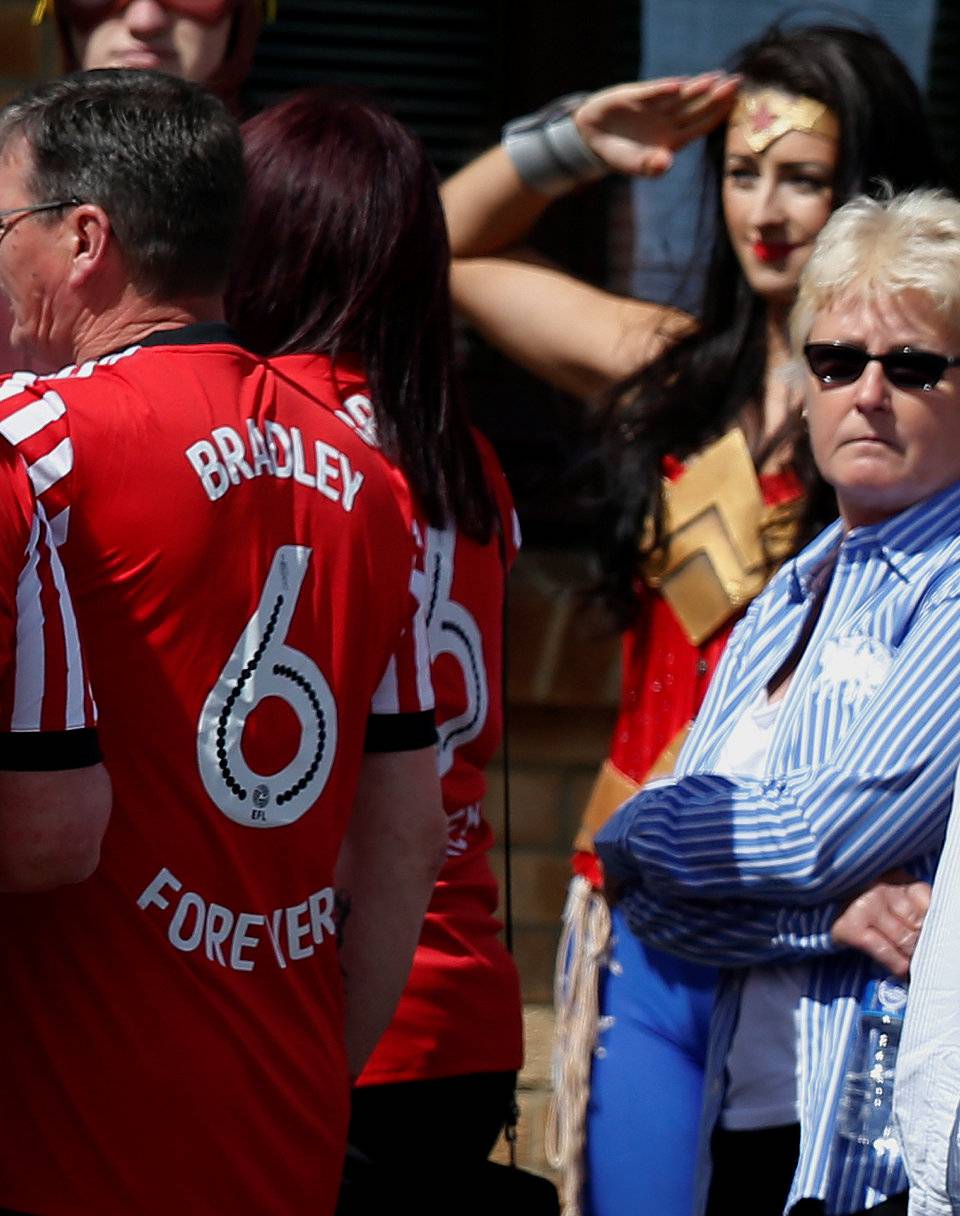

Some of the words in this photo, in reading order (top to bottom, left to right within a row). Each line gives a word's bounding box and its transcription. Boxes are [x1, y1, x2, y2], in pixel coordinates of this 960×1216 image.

[185, 418, 365, 513] BRADLEY
[196, 544, 338, 828] 6
[251, 809, 267, 821] EFL
[136, 867, 336, 972] FOREVER
